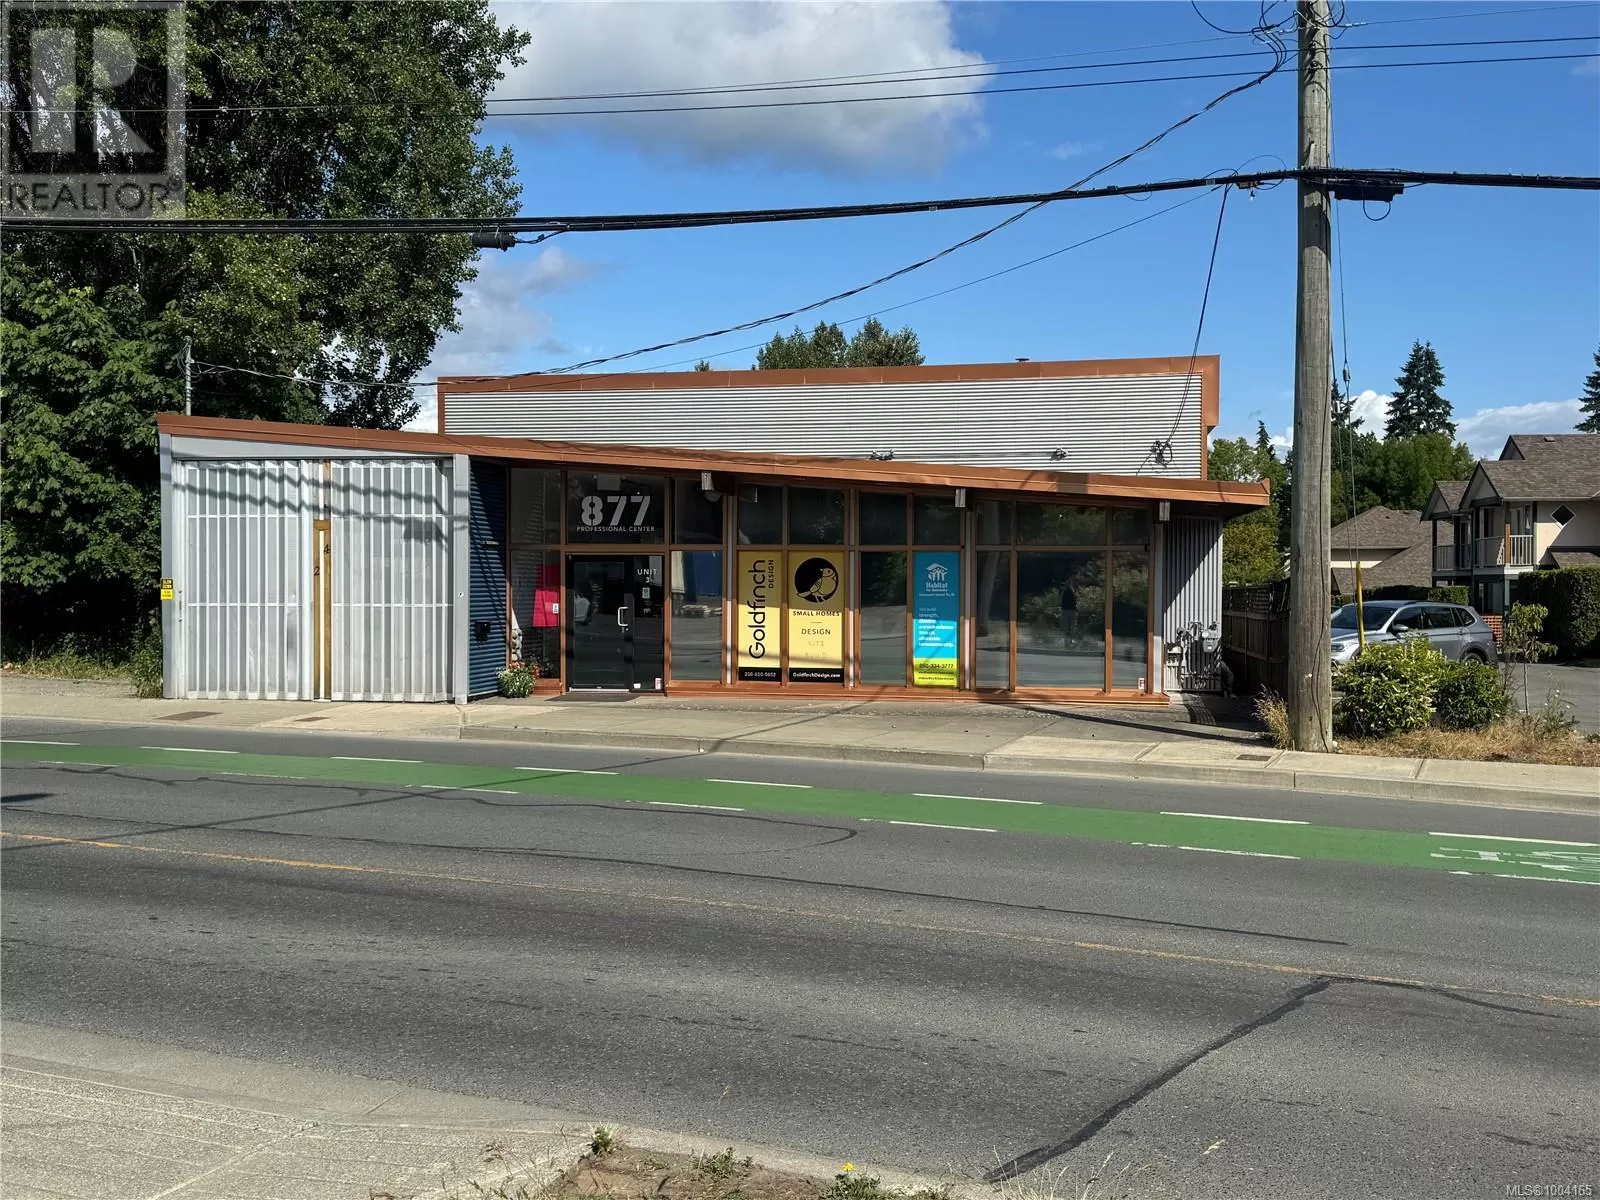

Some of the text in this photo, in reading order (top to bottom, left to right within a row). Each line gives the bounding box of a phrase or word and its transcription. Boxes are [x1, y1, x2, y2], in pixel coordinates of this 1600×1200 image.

[581, 495, 651, 526] 877
[313, 566, 320, 577] 2
[747, 559, 766, 659] Goldfinch
